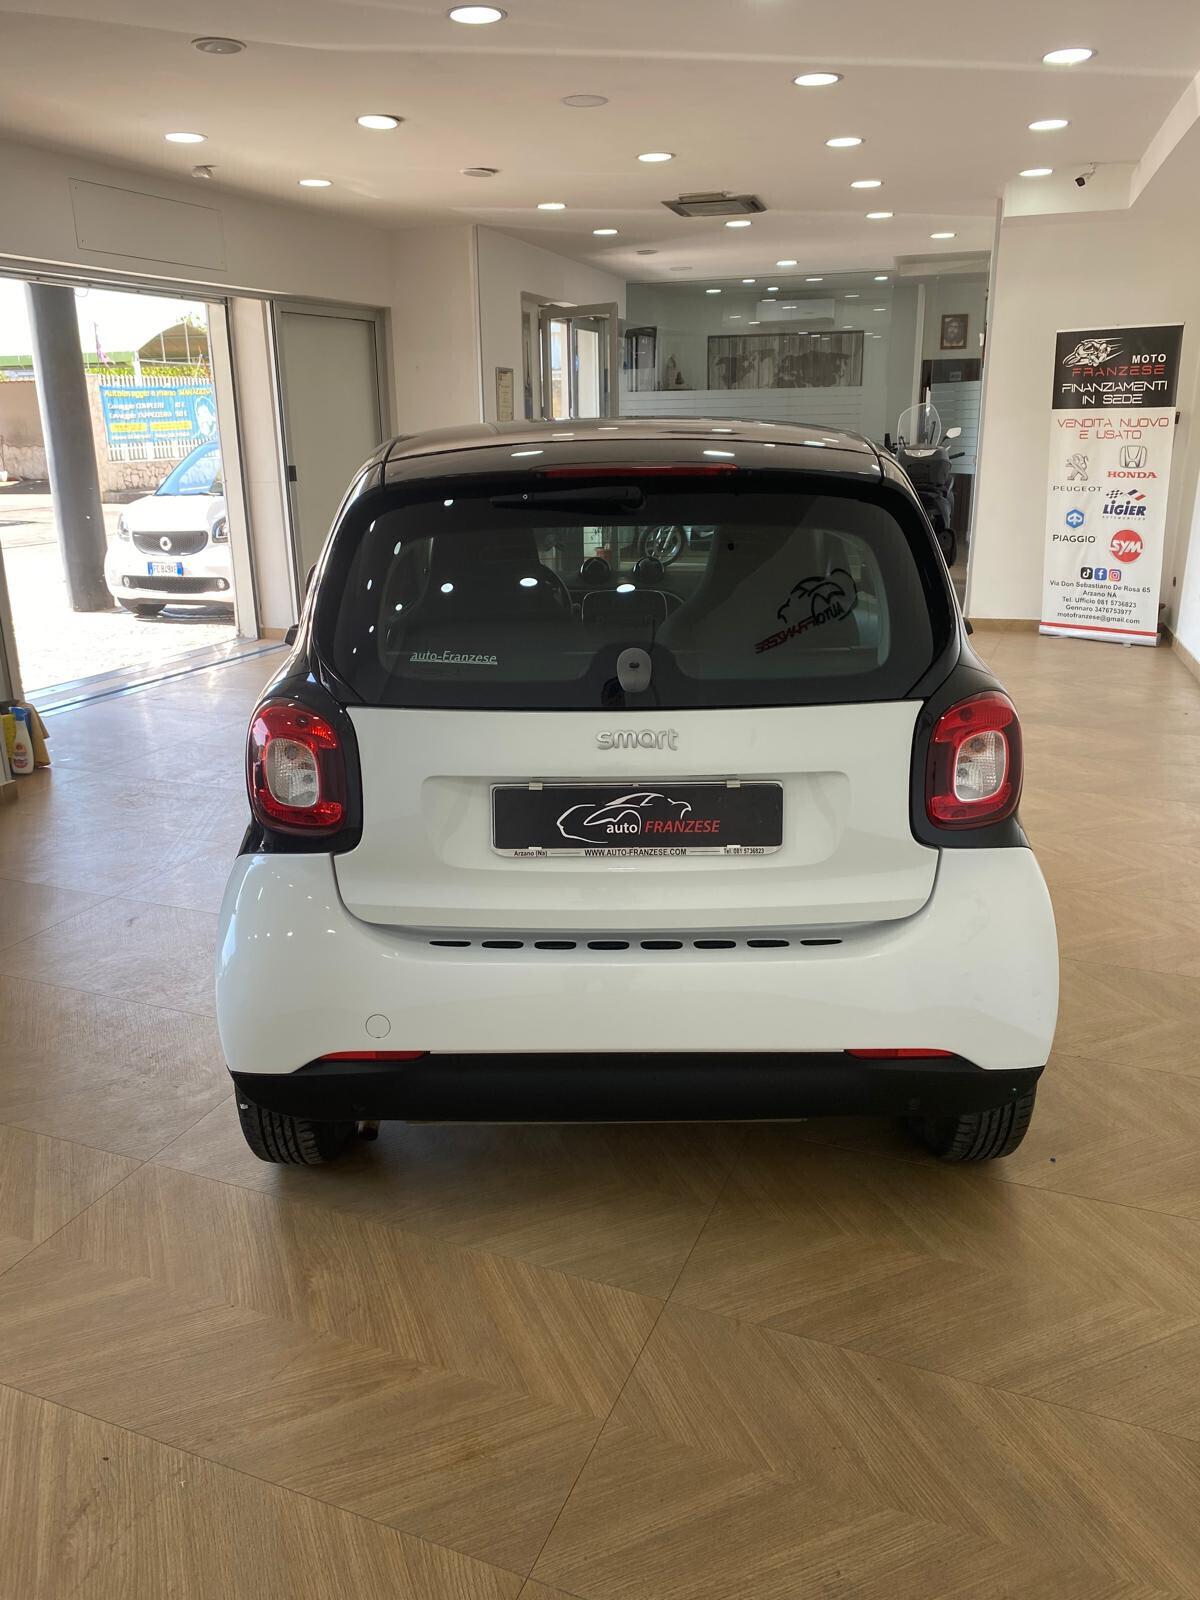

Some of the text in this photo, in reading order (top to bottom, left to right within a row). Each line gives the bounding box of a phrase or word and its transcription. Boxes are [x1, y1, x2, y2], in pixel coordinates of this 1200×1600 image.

[1132, 354, 1166, 364] MOTO
[1072, 364, 1166, 376] FRANZESE
[1062, 380, 1167, 392] FINANZIAMENTI
[1082, 394, 1144, 405] IN SEDE
[1058, 418, 1169, 428] VENDITA NUOVO
[1080, 430, 1141, 439] E USATO
[1052, 534, 1096, 543] PIAGGIO
[1110, 540, 1142, 556] SYM
[1057, 612, 1140, 624] motofranzese@gmail.com
[410, 650, 498, 664] auto-Franzese
[596, 729, 678, 751] smart
[606, 820, 720, 834] auto FRANZESE
